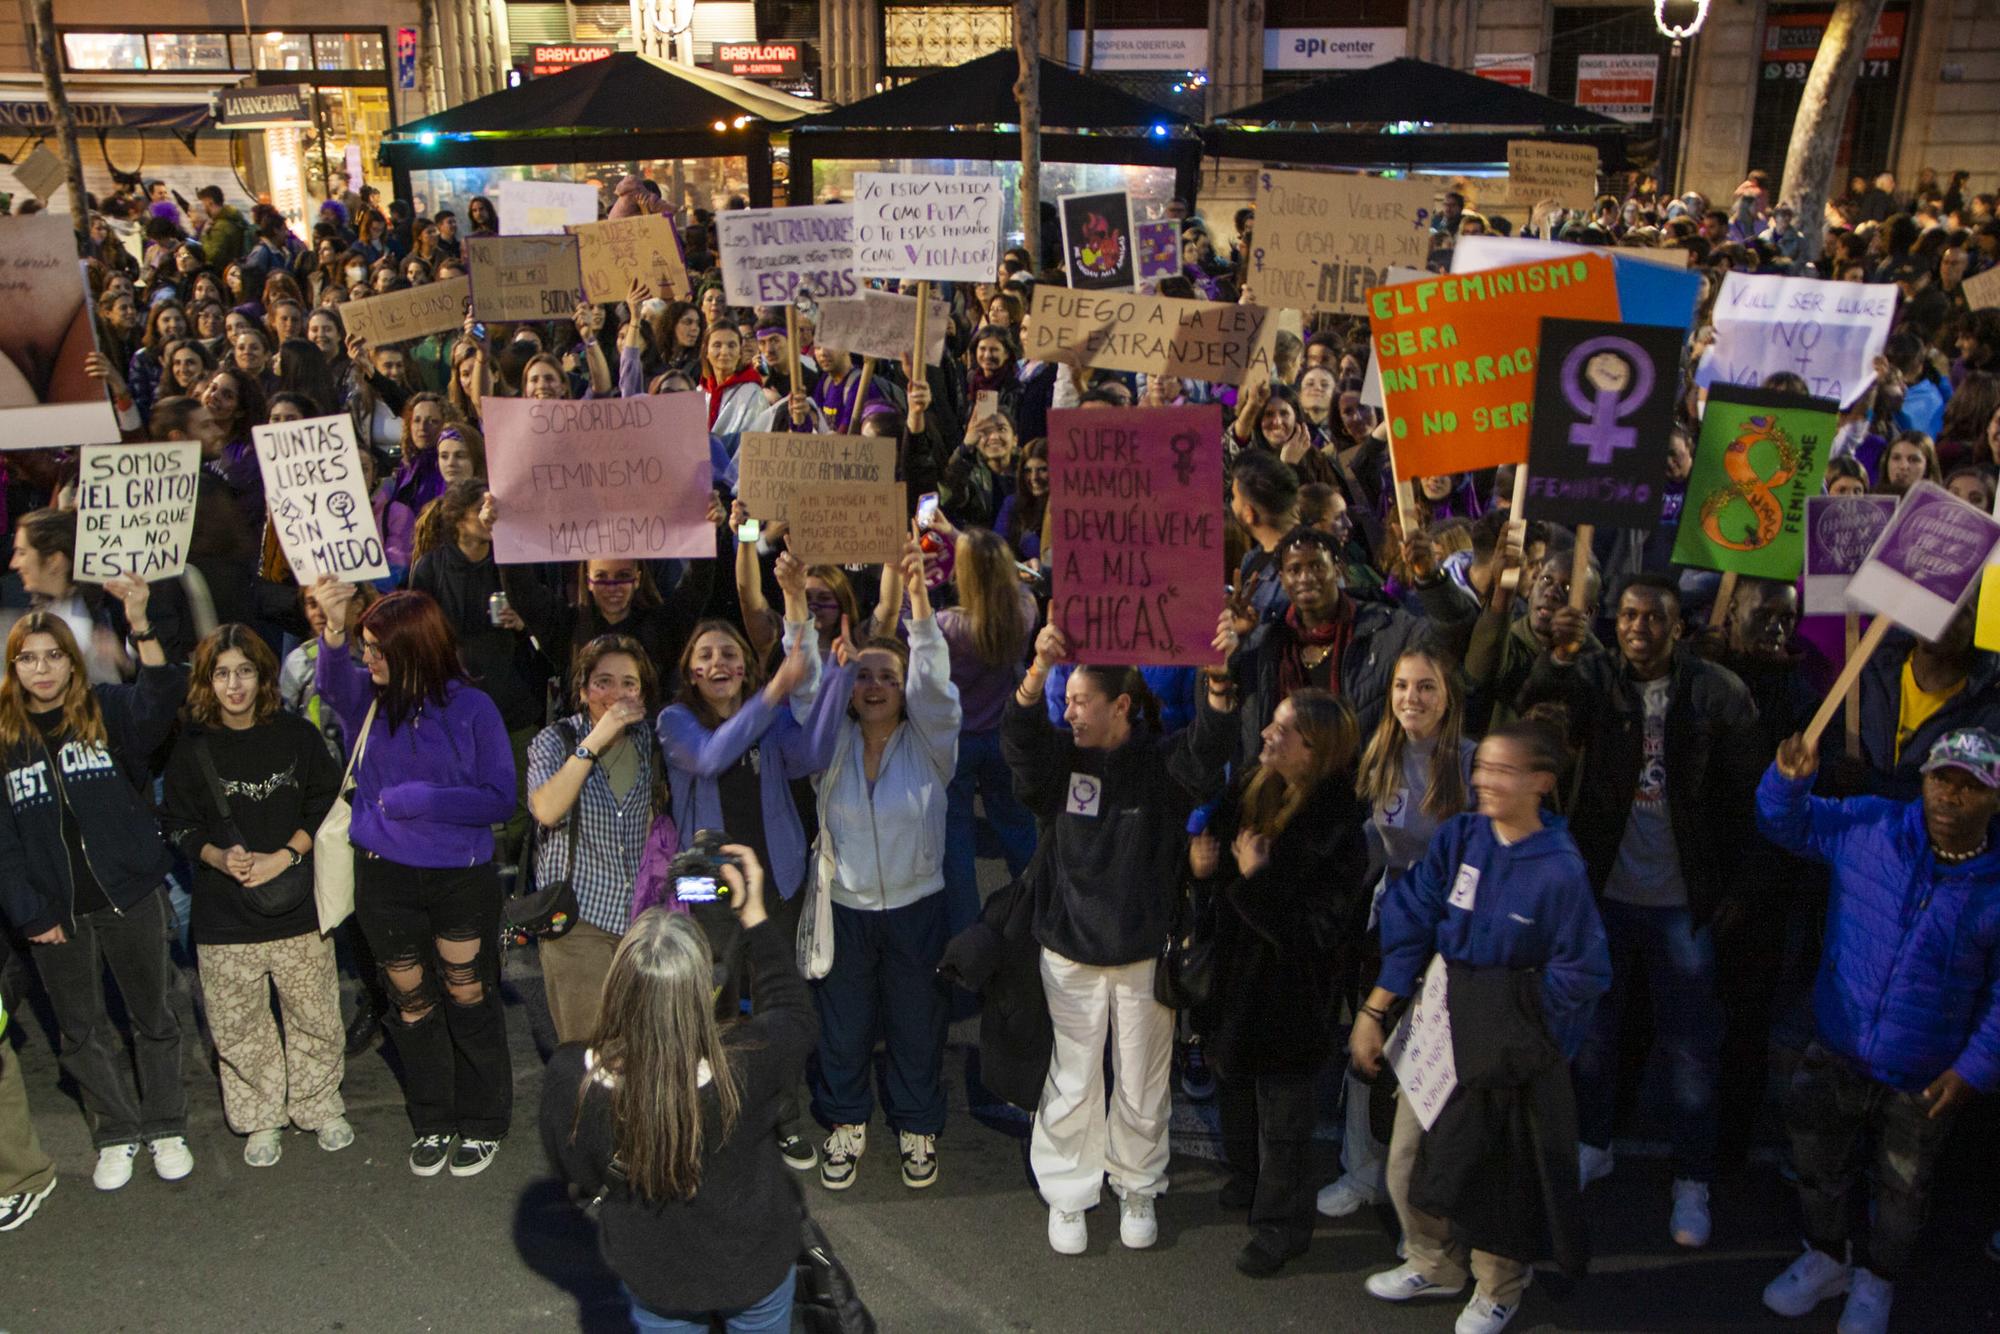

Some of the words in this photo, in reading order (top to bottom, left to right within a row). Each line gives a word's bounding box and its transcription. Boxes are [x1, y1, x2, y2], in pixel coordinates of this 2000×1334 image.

[535, 48, 611, 62] BABYLONIA
[720, 46, 796, 61] BABYLONIA
[1136, 40, 1186, 50] OBERTURA
[1294, 37, 1327, 58] api
[1330, 40, 1375, 53] center
[1785, 62, 1806, 78] 93
[226, 97, 240, 116] LA
[240, 93, 300, 115] VANGUARDIA
[891, 181, 930, 197] ESTOY
[935, 182, 992, 195] VESTIDA
[879, 203, 921, 221] COMO
[860, 224, 873, 242] O
[900, 224, 937, 240] ESTAS
[1270, 231, 1280, 251] A
[1296, 230, 1335, 254] CASA
[1345, 232, 1385, 255] SOLA
[1395, 235, 1421, 256] SIN
[861, 247, 895, 262] COMO
[758, 267, 857, 301] ESPSAS
[1371, 290, 1415, 321] EL
[1416, 260, 1589, 313] FEMINISMO
[1788, 291, 1825, 313] SER
[1041, 294, 1136, 323] FUEGO
[1148, 303, 1164, 326] A
[1178, 307, 1204, 329] LA
[1217, 309, 1266, 342] LEY
[1036, 325, 1073, 350] DE
[1380, 324, 1459, 357] SERA
[1772, 318, 1823, 350] NO
[1381, 346, 1540, 396] ANTIRRAC
[529, 400, 653, 435] SORORIDAD
[1391, 416, 1408, 439] O
[1422, 410, 1458, 437] NO
[263, 422, 350, 462] JUNTAS,
[769, 438, 781, 458] TE
[785, 437, 835, 461] ASUSTAN
[1067, 426, 1143, 466] SUFRE
[90, 449, 183, 481] SOMOS
[275, 454, 349, 490] LIBRES
[531, 456, 663, 492] FEMINISMO
[126, 472, 198, 510] GRITO!
[303, 492, 318, 516] Y
[874, 494, 889, 506] ME
[86, 513, 112, 532] DE
[121, 511, 152, 529] LAS
[156, 506, 192, 526] QUE
[800, 509, 849, 523] GUSTAN
[859, 510, 881, 524] LAS
[1063, 502, 1215, 550] DEVUÉLVEME
[98, 534, 123, 549] YA
[145, 529, 171, 547] NO
[285, 519, 323, 547] SIN
[548, 515, 667, 556] MACHISMO
[800, 525, 858, 539] MUJERES
[875, 525, 895, 537] NO
[311, 537, 383, 576] MIEDO
[1062, 551, 1083, 583] A
[1102, 551, 1153, 588] MIS
